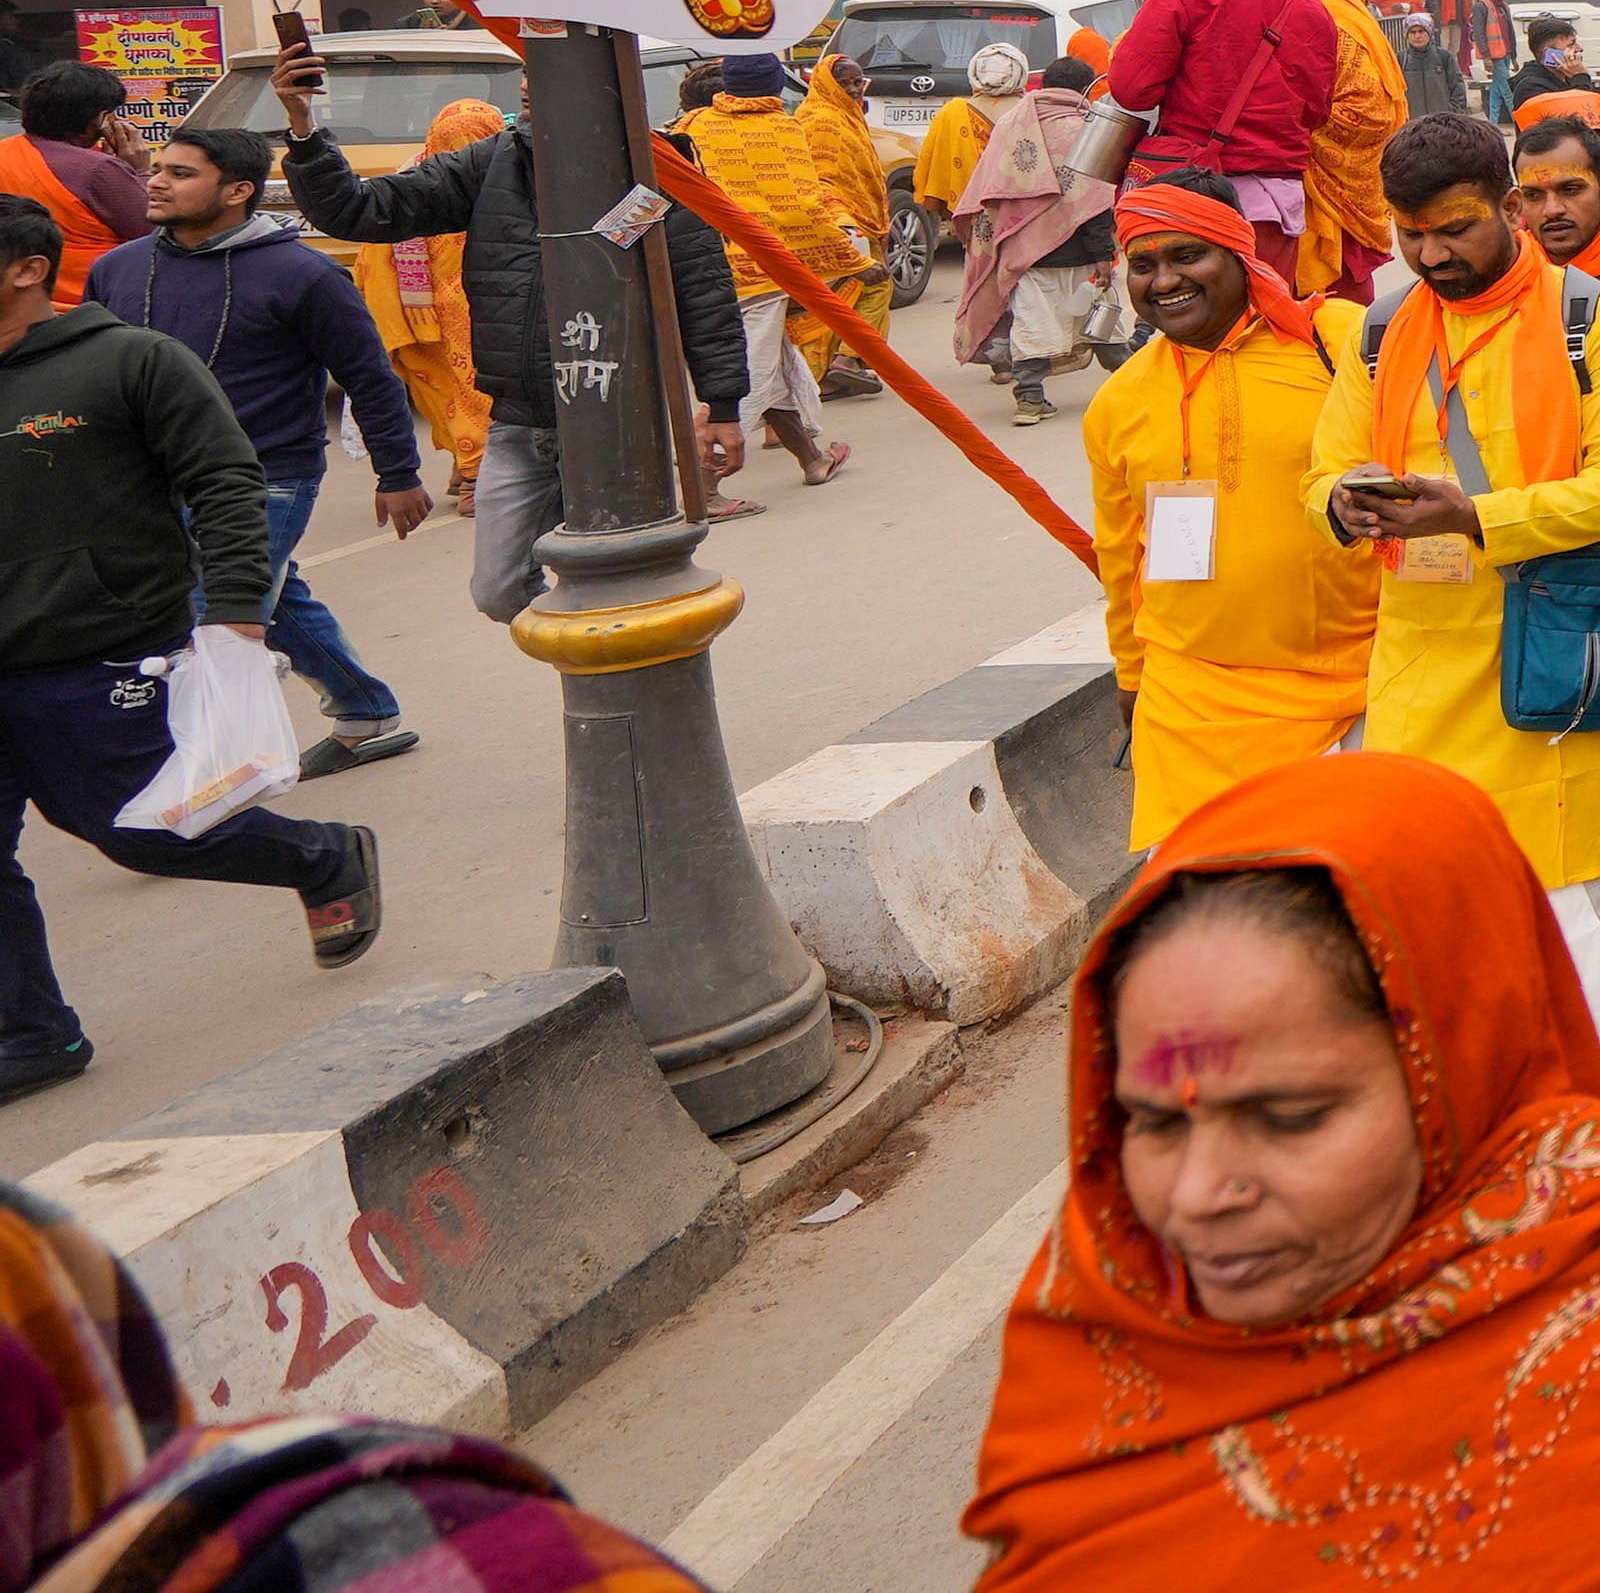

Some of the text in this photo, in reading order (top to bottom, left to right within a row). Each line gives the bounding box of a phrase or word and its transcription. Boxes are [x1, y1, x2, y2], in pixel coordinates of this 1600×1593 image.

[989, 15, 1040, 27] POLICE
[117, 28, 181, 47] दीपावली
[124, 48, 176, 65] धमाका
[560, 310, 604, 351] श्री
[554, 359, 619, 405] राम
[16, 411, 88, 438] ORIGINAL
